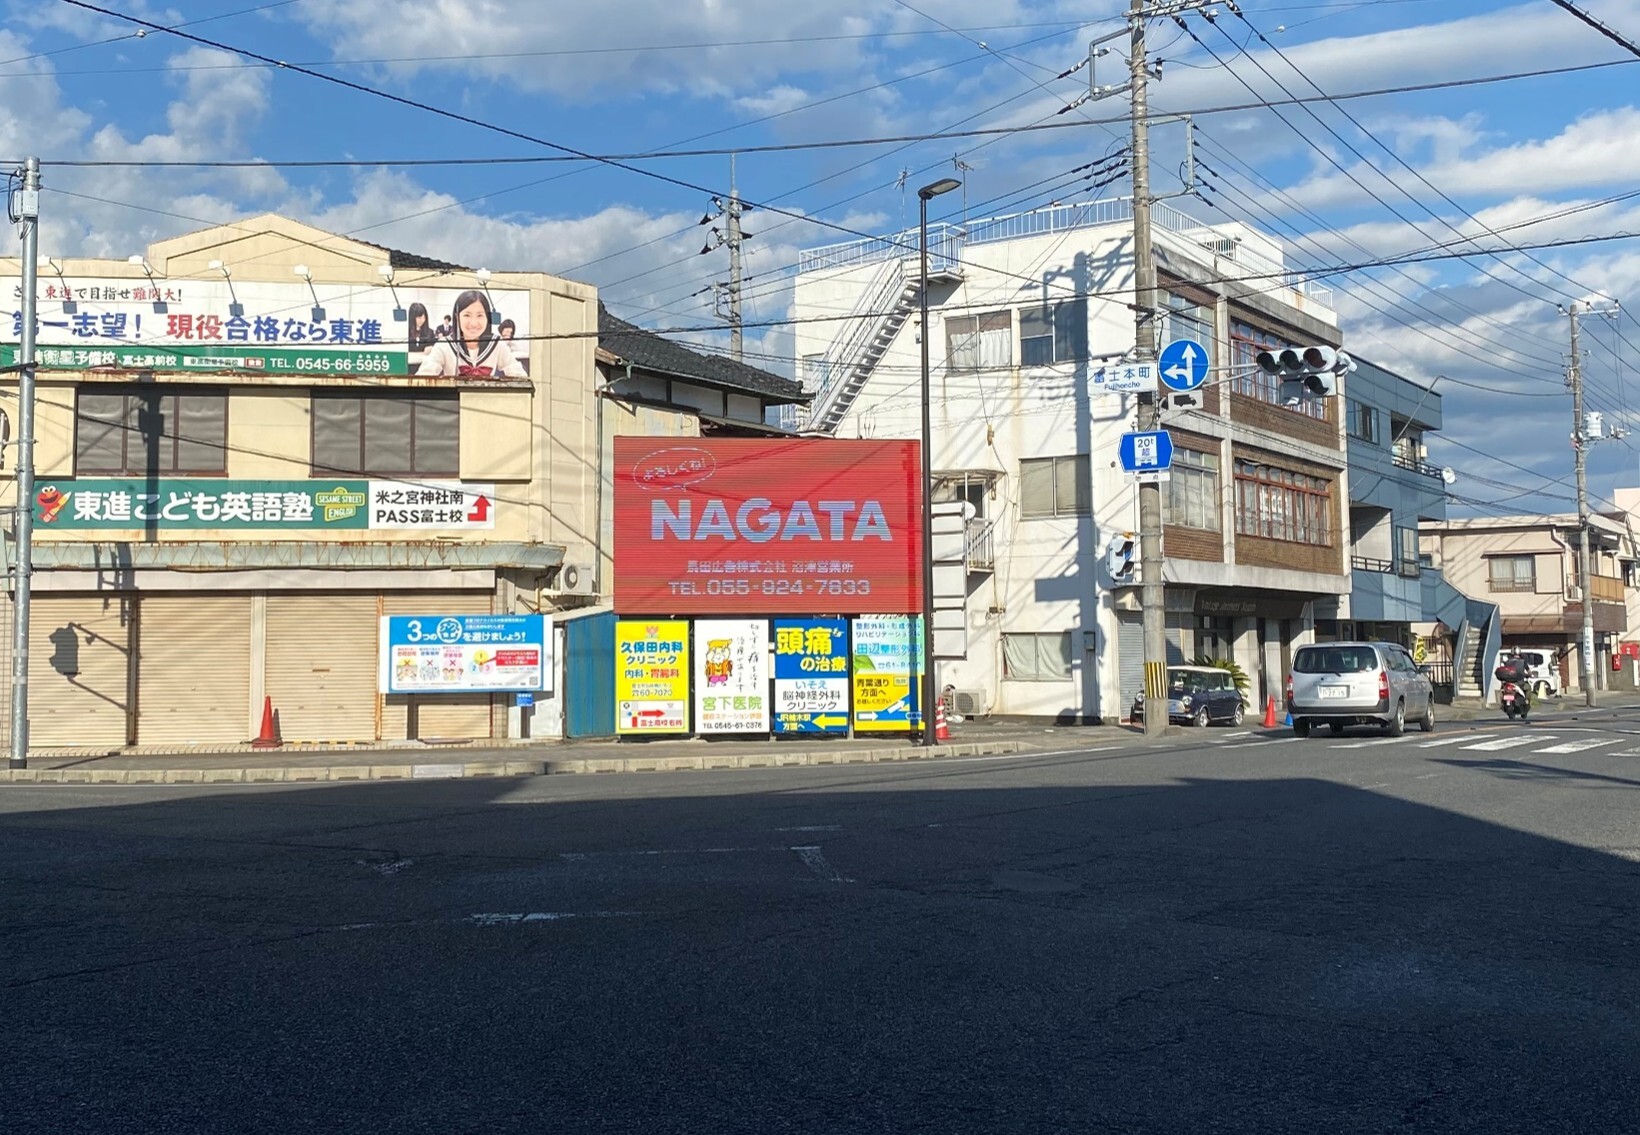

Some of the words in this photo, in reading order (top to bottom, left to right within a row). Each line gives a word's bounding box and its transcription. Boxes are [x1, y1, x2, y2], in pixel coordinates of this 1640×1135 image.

[13, 285, 182, 302] さ、東進で目指せ難関大!
[166, 313, 383, 344] 現役合格なら東進
[375, 490, 464, 506] 米之宮神社南
[73, 490, 315, 522] 東進こども英語塾
[375, 509, 463, 524] PASS富士校
[651, 497, 894, 543] NAGATA
[621, 641, 683, 654] 久保田内科
[776, 627, 833, 656] 頭痛
[626, 655, 677, 665] クリニック
[799, 656, 847, 672] の治療
[794, 680, 828, 690] いそえ
[782, 690, 841, 701] 脳神経外科
[702, 696, 763, 711] 宮下医院
[786, 701, 838, 711] クリニック
